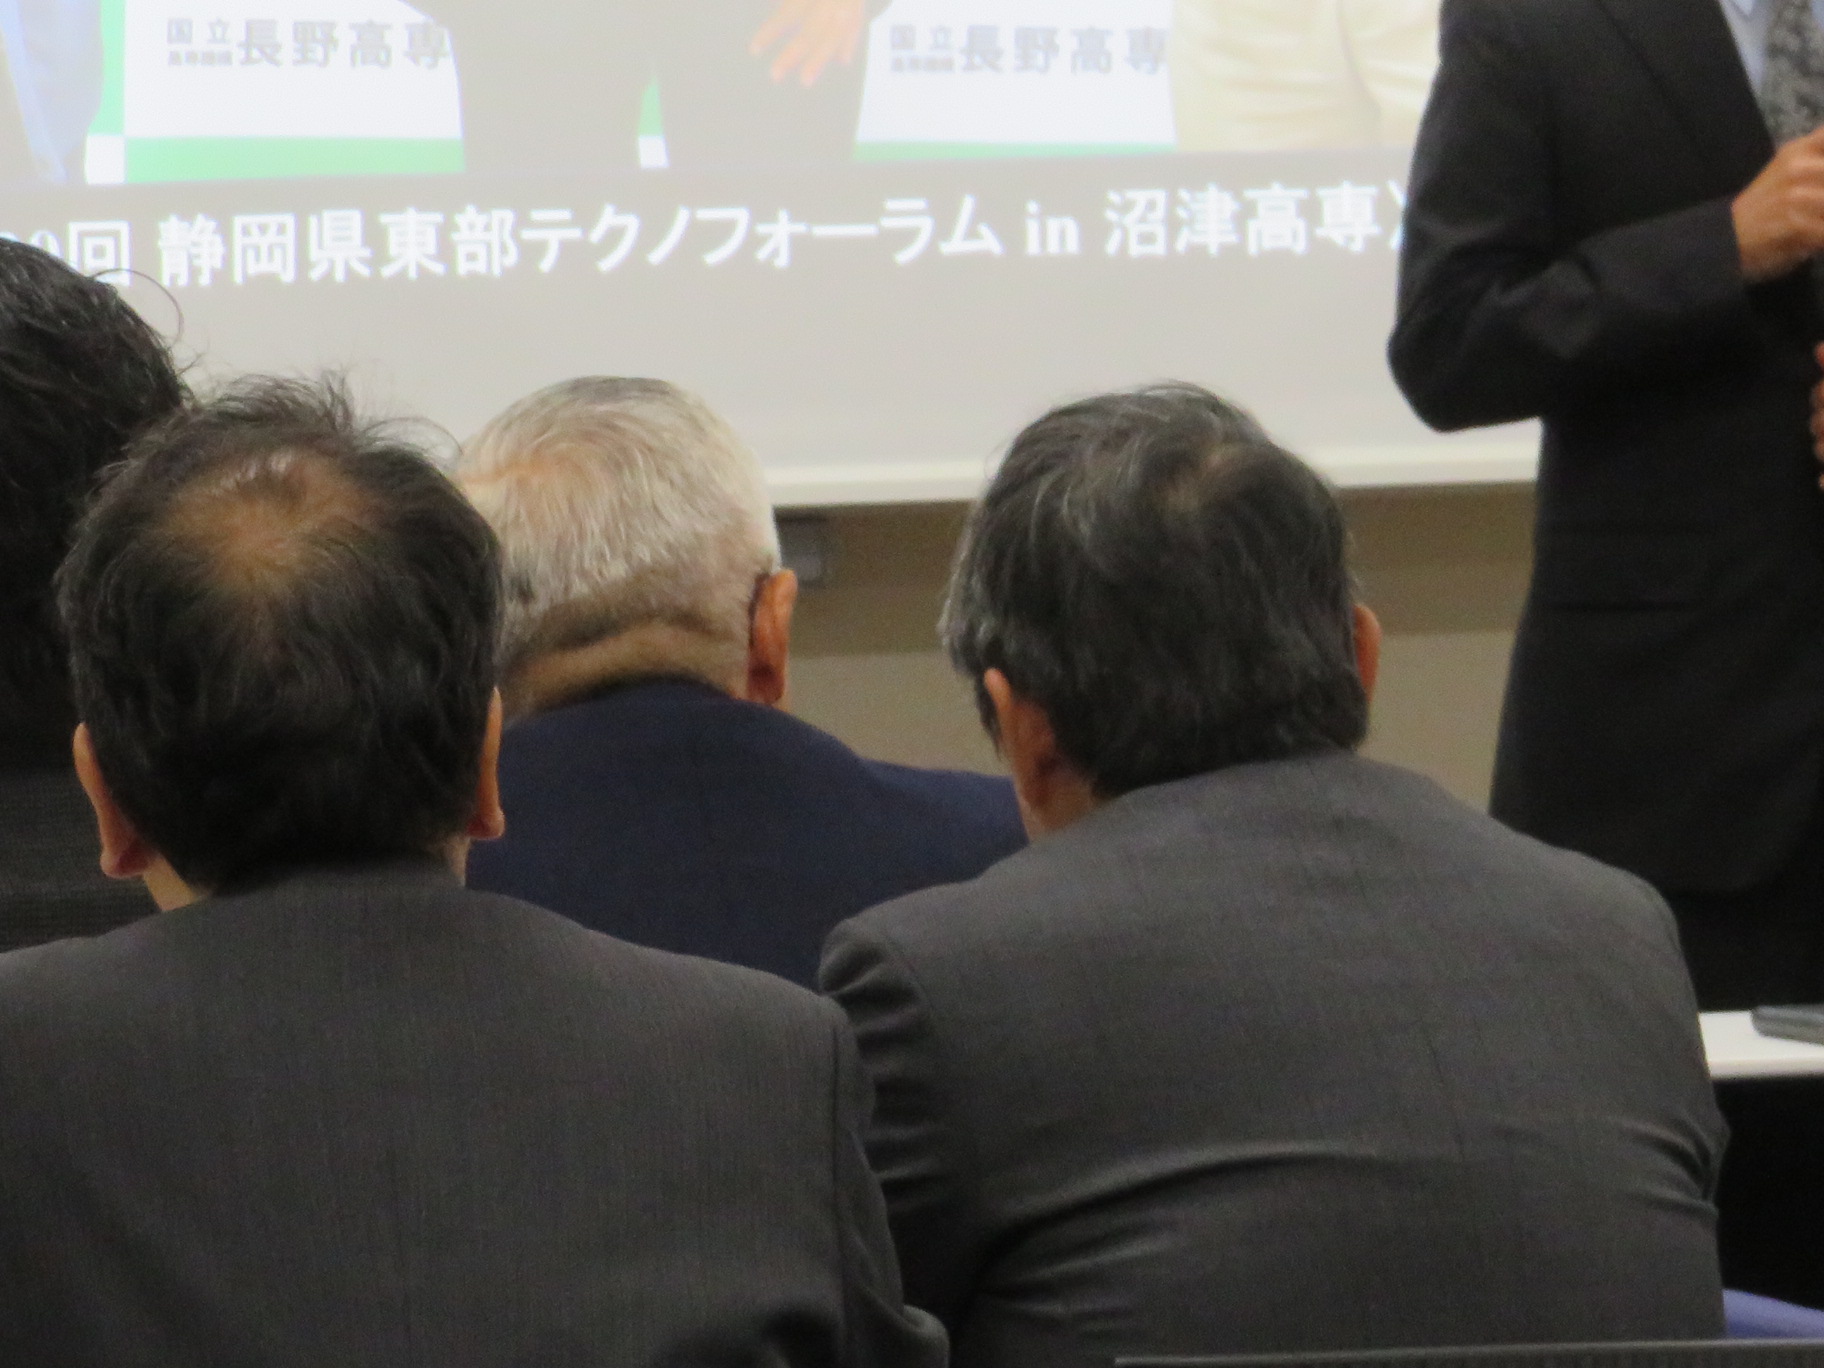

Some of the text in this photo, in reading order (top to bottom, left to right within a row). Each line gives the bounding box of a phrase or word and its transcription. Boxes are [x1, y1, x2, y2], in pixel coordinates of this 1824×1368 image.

[236, 18, 451, 69] 長野高専
[959, 24, 1169, 75] 長野高専
[156, 194, 1006, 287] 静岡県東部テクノフォーラム
[1024, 199, 1082, 256] in
